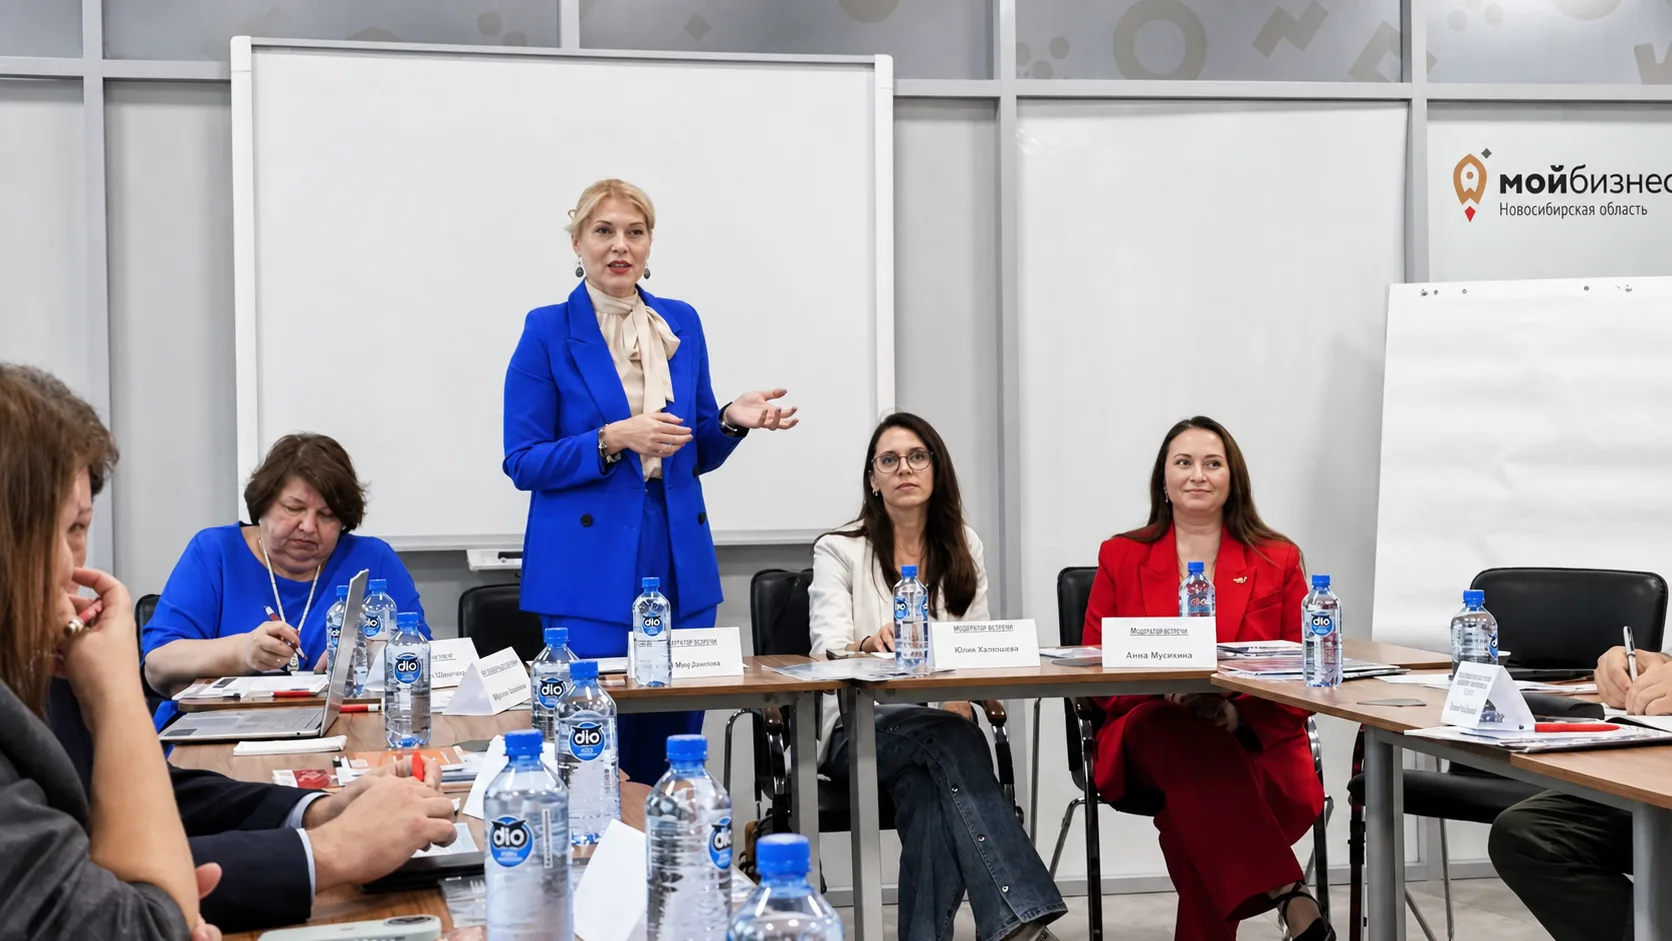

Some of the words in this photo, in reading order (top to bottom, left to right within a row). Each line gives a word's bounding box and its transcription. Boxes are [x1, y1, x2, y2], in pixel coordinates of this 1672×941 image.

[1499, 202, 1596, 219] Новосибирская
[1599, 201, 1648, 216] область
[954, 646, 977, 654] Юлия
[1150, 652, 1193, 660] Мусихина
